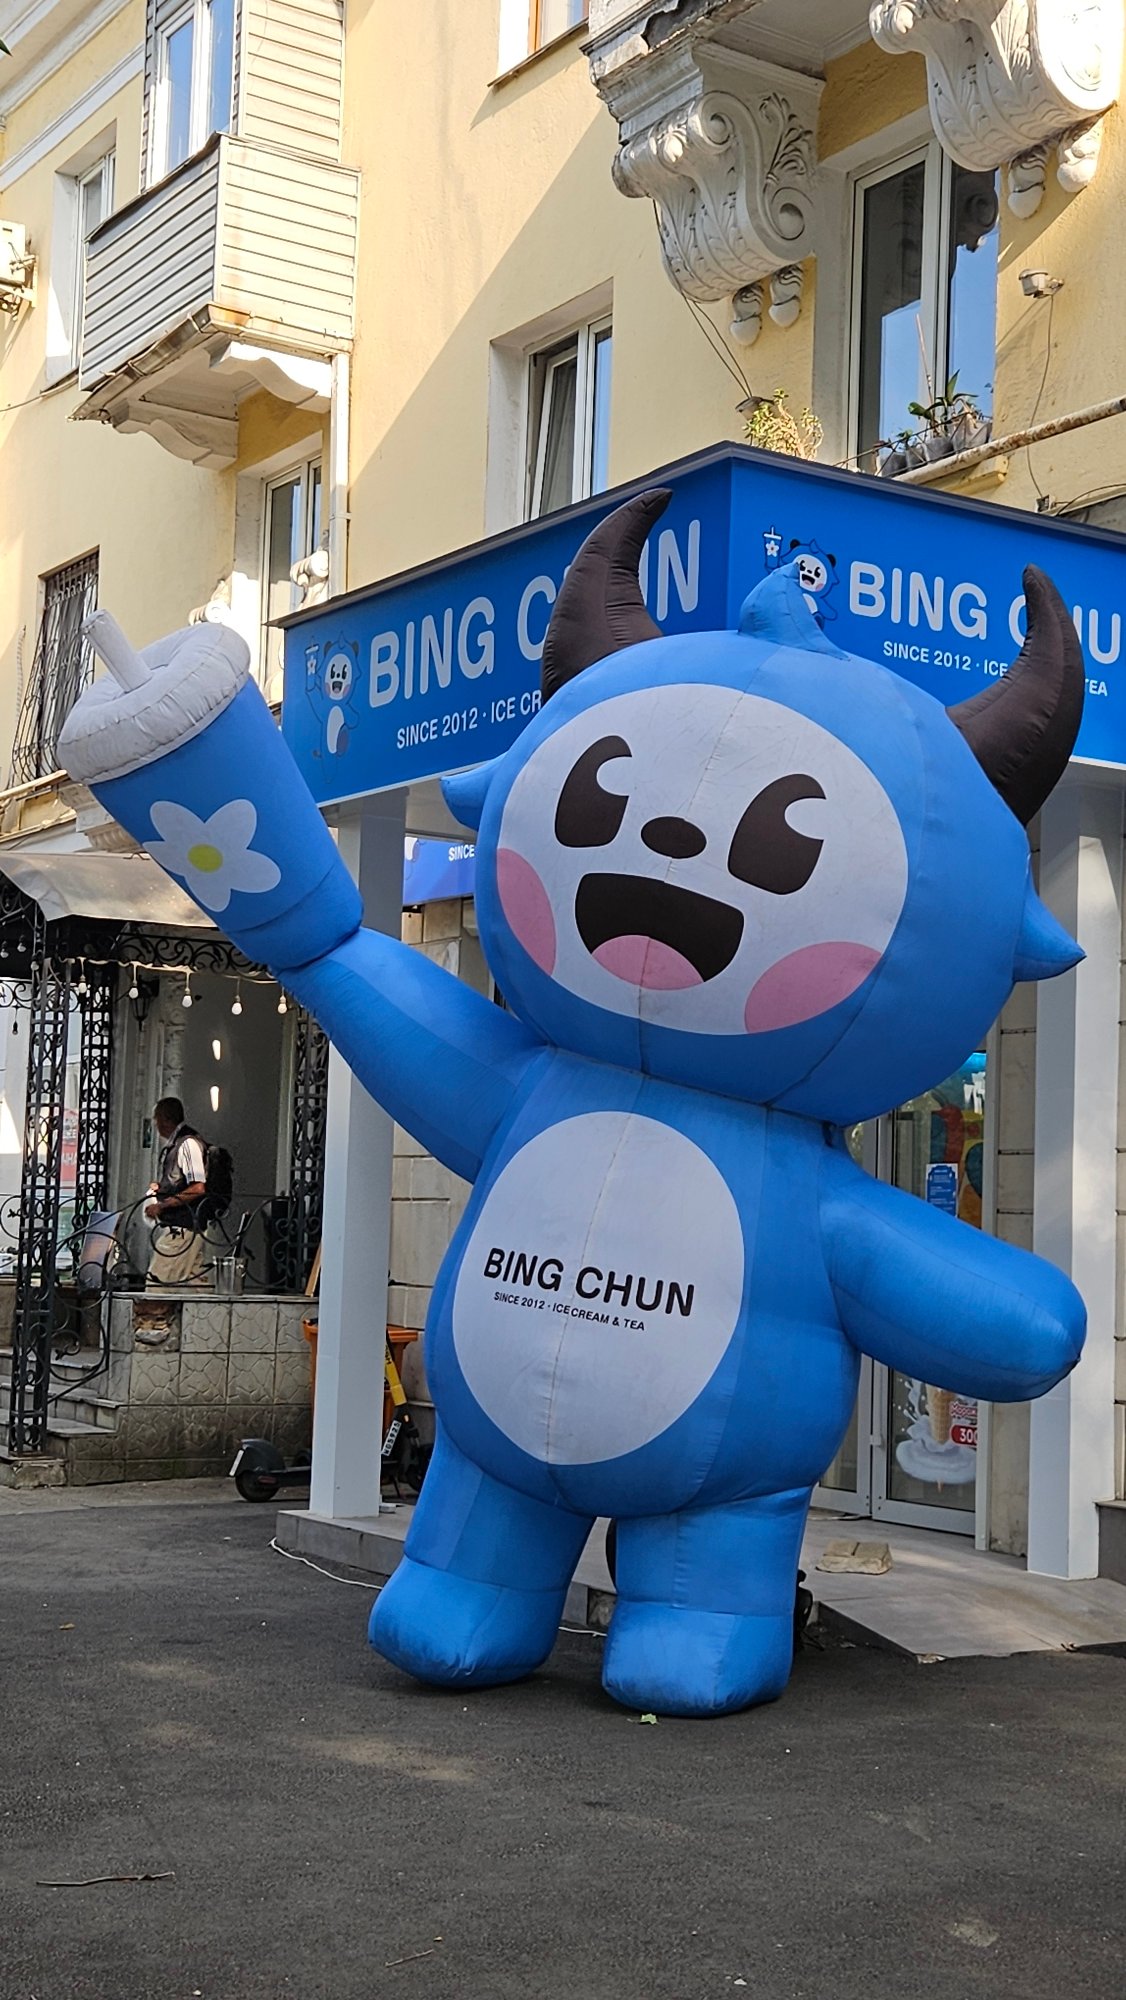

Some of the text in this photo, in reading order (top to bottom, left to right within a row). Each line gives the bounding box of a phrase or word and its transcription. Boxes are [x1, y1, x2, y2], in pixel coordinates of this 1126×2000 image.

[369, 520, 700, 708] BING CN
[850, 560, 987, 640] BING
[883, 640, 929, 663] SINCE
[934, 651, 971, 671] 2012
[1085, 678, 1108, 697] EA
[397, 718, 438, 749] SINCE
[442, 707, 478, 736] 2012
[491, 697, 516, 723] ICE
[448, 844, 475, 862] SINCE
[483, 1247, 695, 1317] BING CHUN
[494, 1291, 520, 1305] SINCE
[521, 1297, 545, 1310] 2012
[612, 1316, 620, 1327] &
[623, 1318, 645, 1331] TEA
